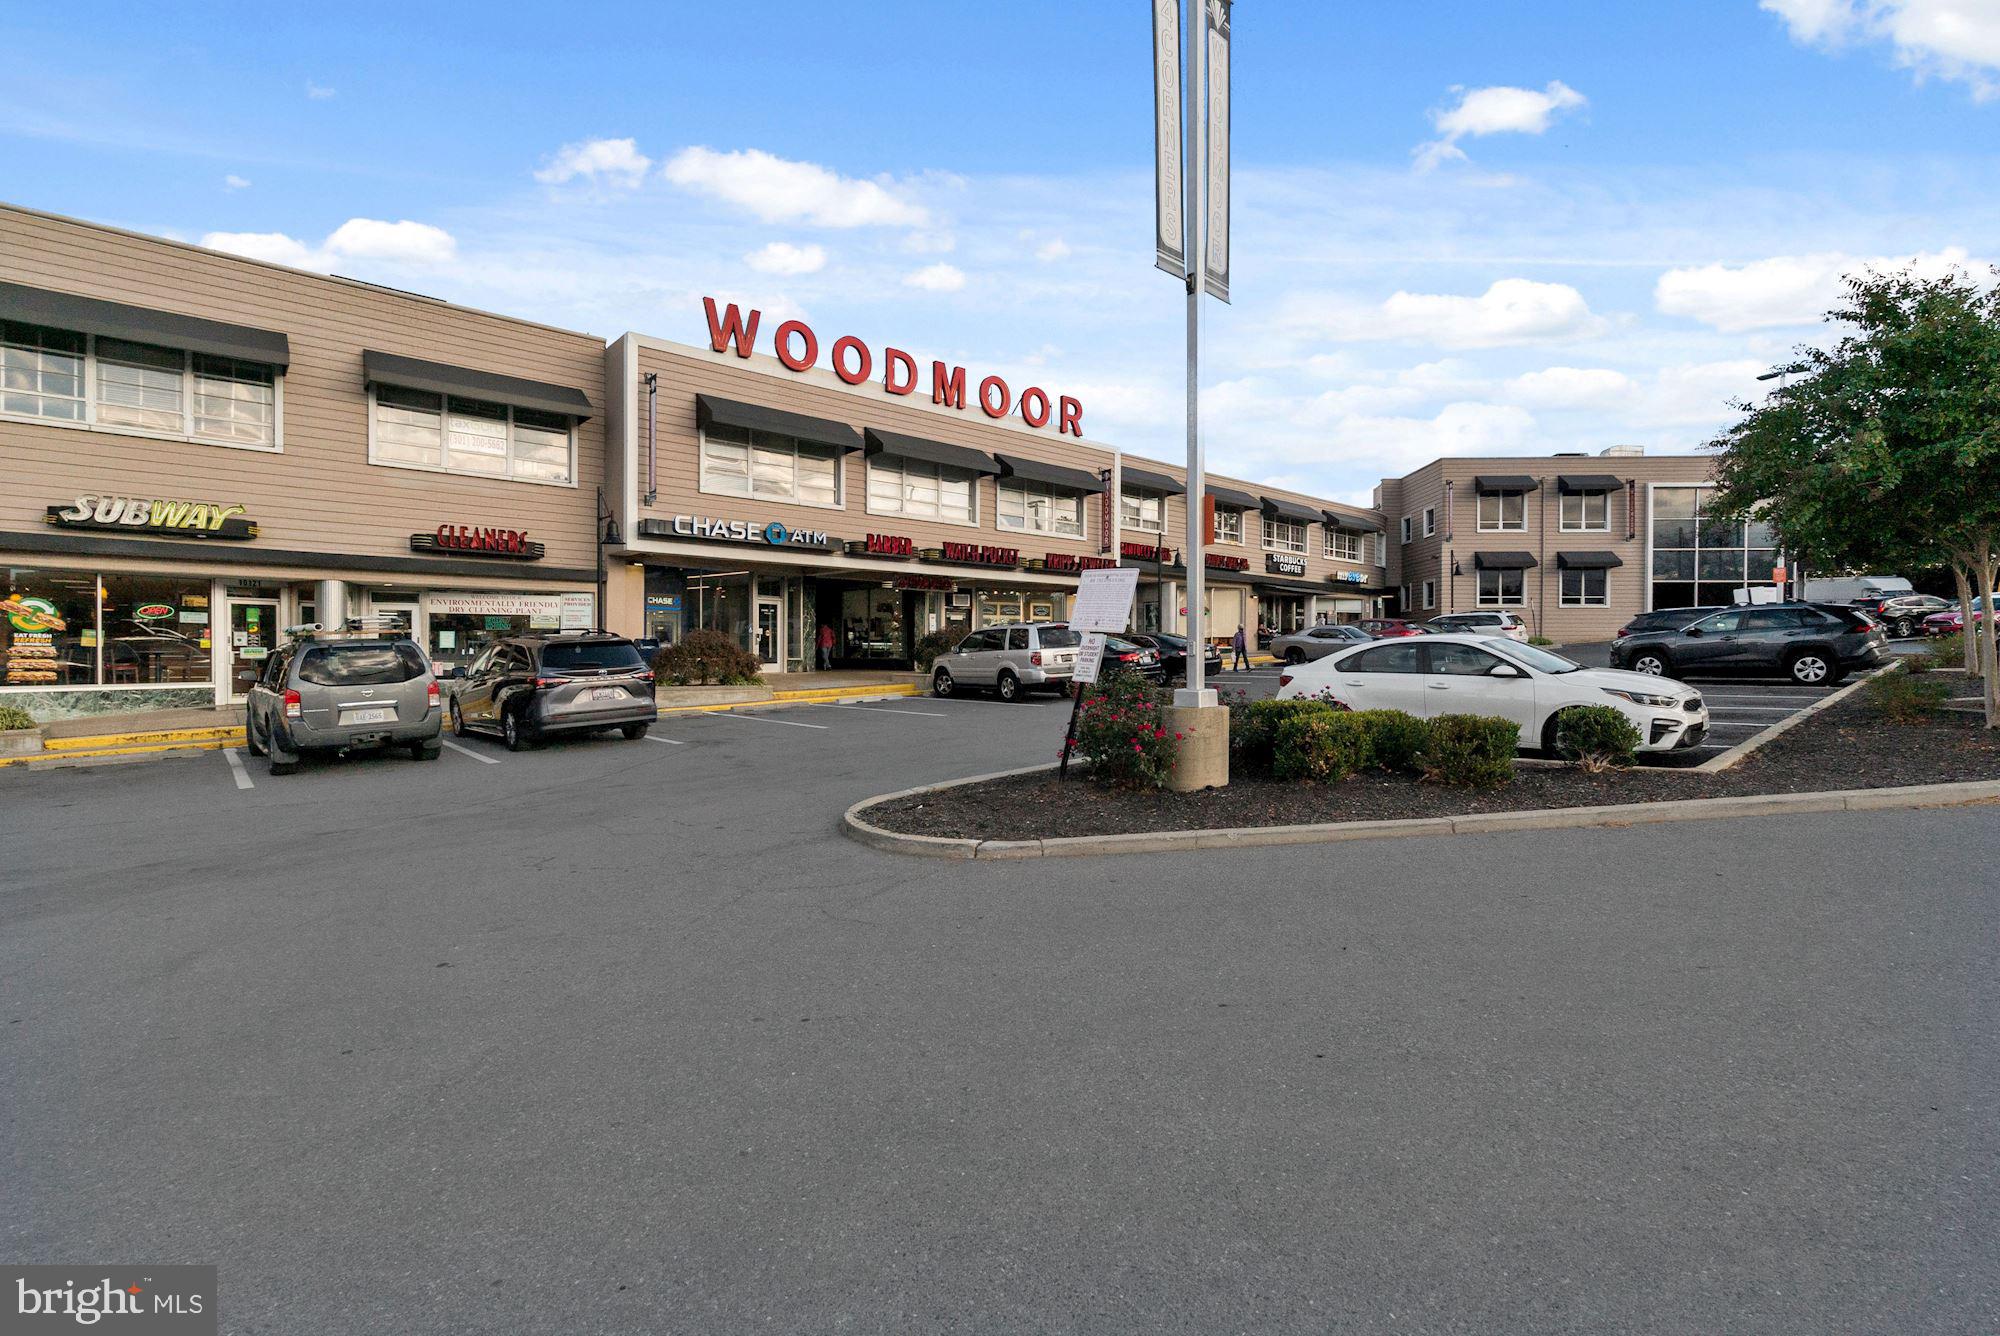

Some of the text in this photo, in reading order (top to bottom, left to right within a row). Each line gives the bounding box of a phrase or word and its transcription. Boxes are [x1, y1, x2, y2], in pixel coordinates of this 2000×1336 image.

[702, 296, 1083, 438] WOODMOOR
[59, 494, 247, 530] SUBWAY
[437, 524, 528, 553] CLEANERS
[673, 514, 827, 545] CHASE ATM
[866, 533, 912, 555] BARBER
[943, 541, 1019, 565] WATCH POCKET
[1273, 553, 1308, 566] STARBUCKS
[1280, 563, 1302, 574] COFFEE
[140, 607, 168, 615] OPEN
[430, 599, 560, 609] ENVIRONMENTALLY FRIENDLY
[647, 596, 673, 605] CHASE
